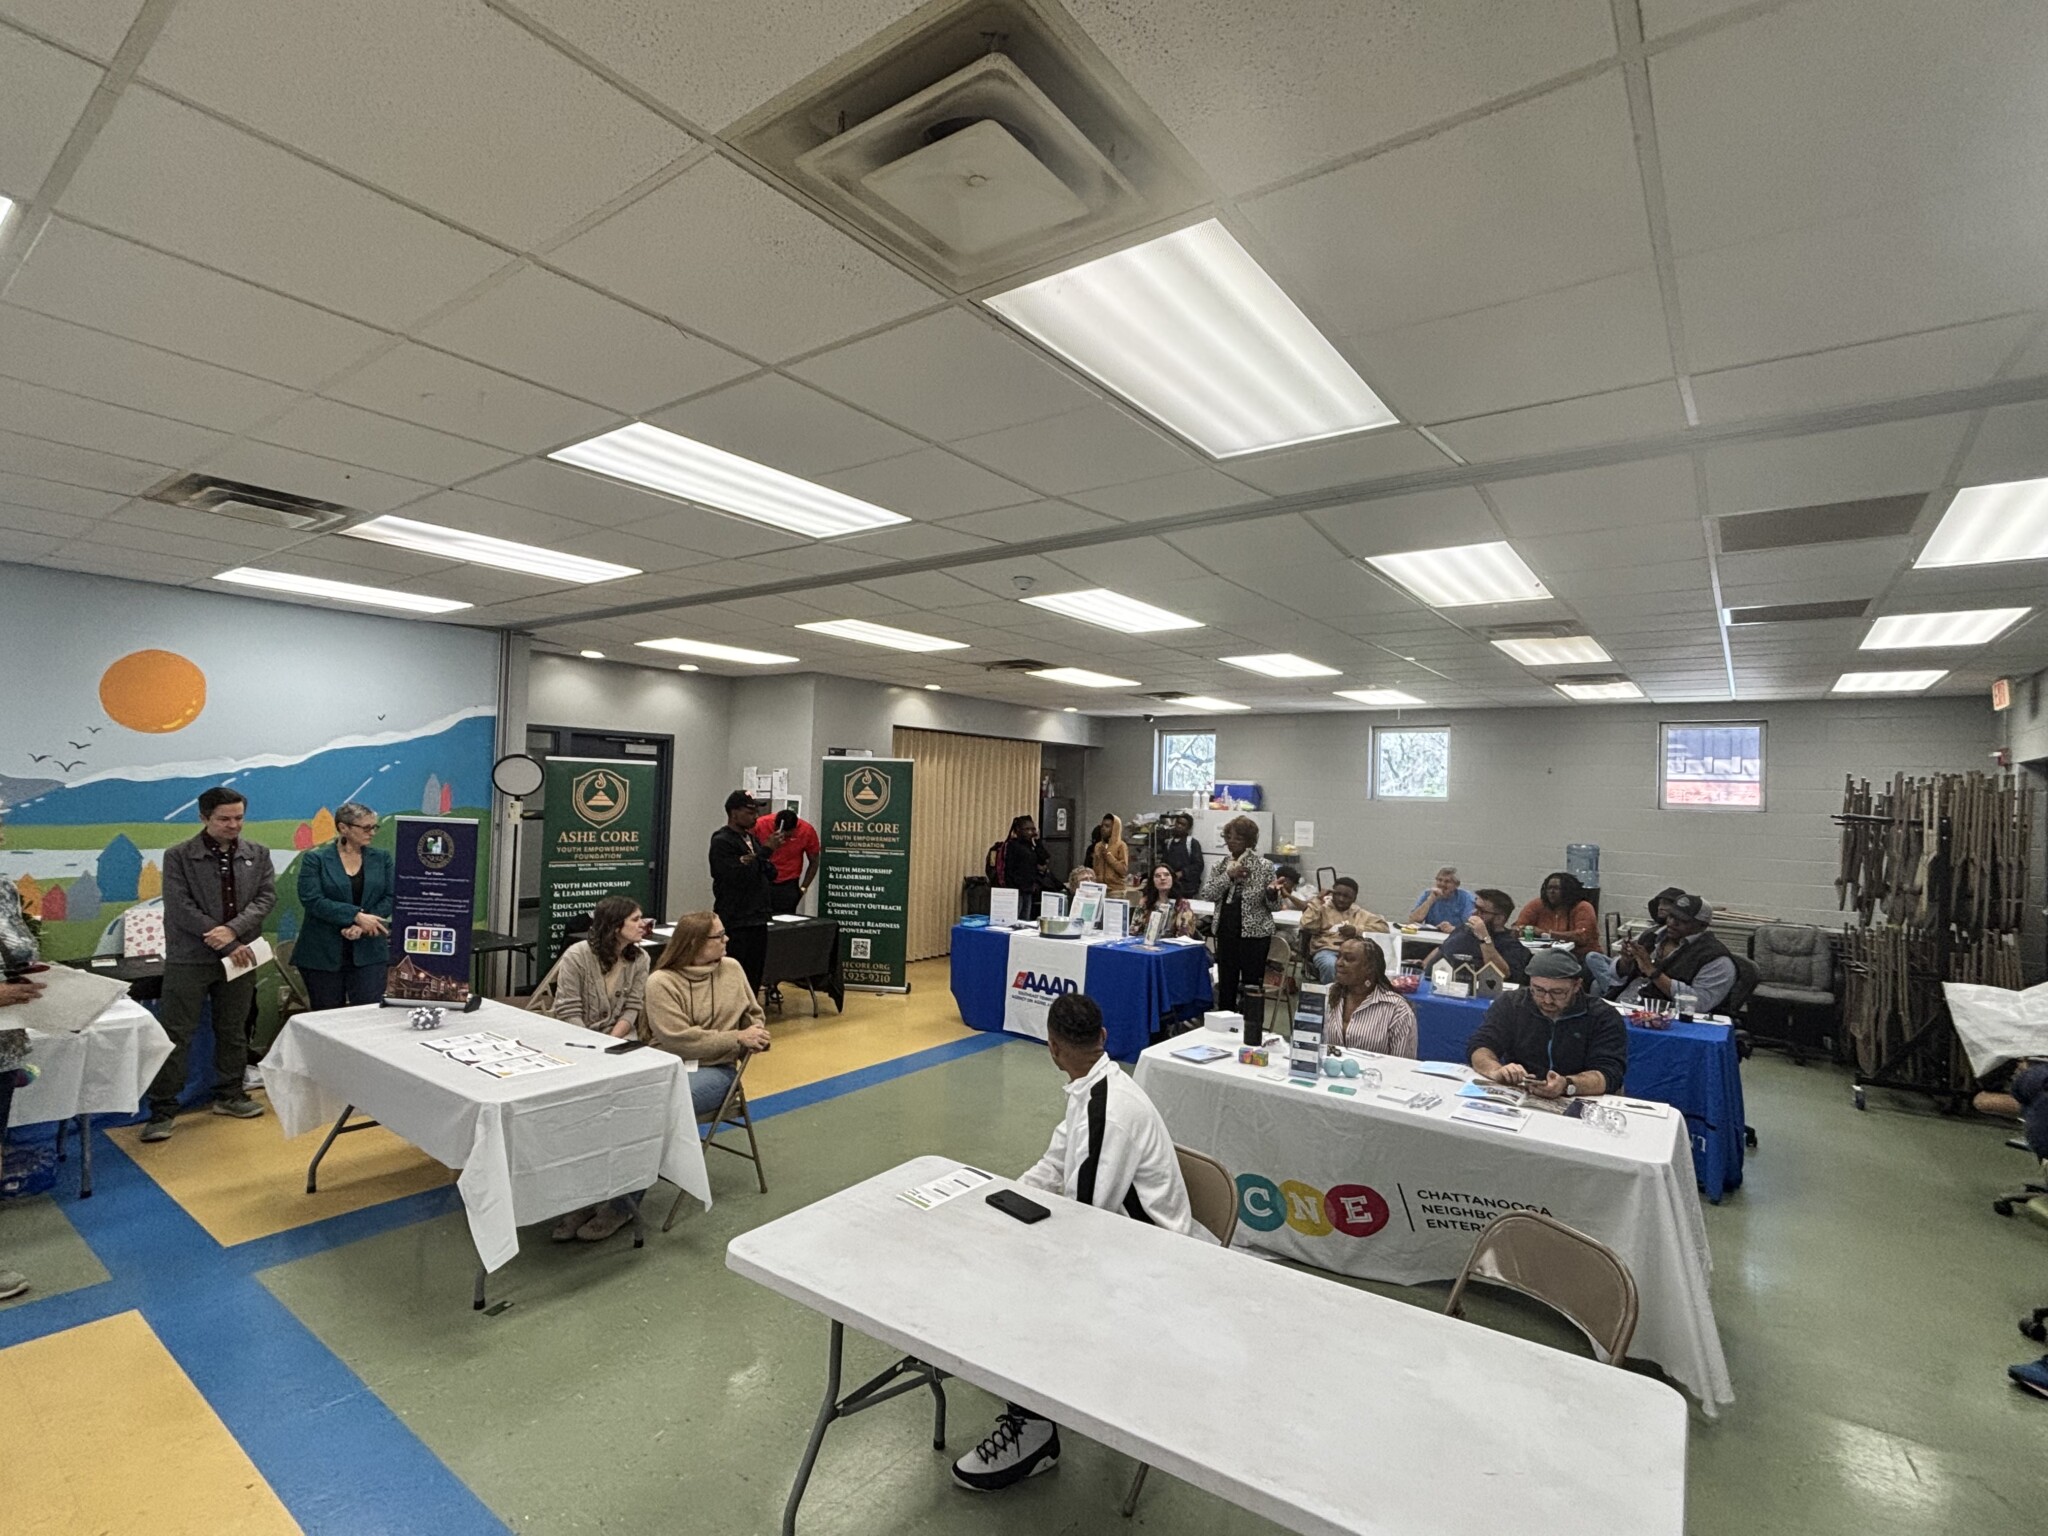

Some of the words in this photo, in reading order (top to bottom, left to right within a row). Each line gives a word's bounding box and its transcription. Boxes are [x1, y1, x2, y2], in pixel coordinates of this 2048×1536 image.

[831, 821, 864, 832] ASHE
[867, 823, 900, 834] CORE
[558, 831, 597, 843] ASHE
[600, 831, 639, 843] CORE
[853, 835, 900, 843] EMPOWERMENT
[845, 841, 885, 849] FOUNDATION
[851, 867, 893, 875] MENTORSHIP
[552, 882, 580, 890] YOUTH
[581, 880, 631, 889] MENTORSHIP
[828, 883, 864, 892] EDUCATION
[553, 890, 560, 898] &
[562, 889, 608, 897] LEADERSHIP
[828, 890, 848, 898] SKILLS
[552, 902, 597, 911] EDUCATION
[827, 901, 866, 910] COMMUNITY
[867, 903, 902, 911] OUTREACH
[552, 910, 577, 918] SKILLS
[866, 921, 900, 929] READINESS
[1023, 971, 1079, 995] AAAD
[1421, 1204, 1498, 1221] NEIGHBO
[1426, 1218, 1485, 1232] ENTER
